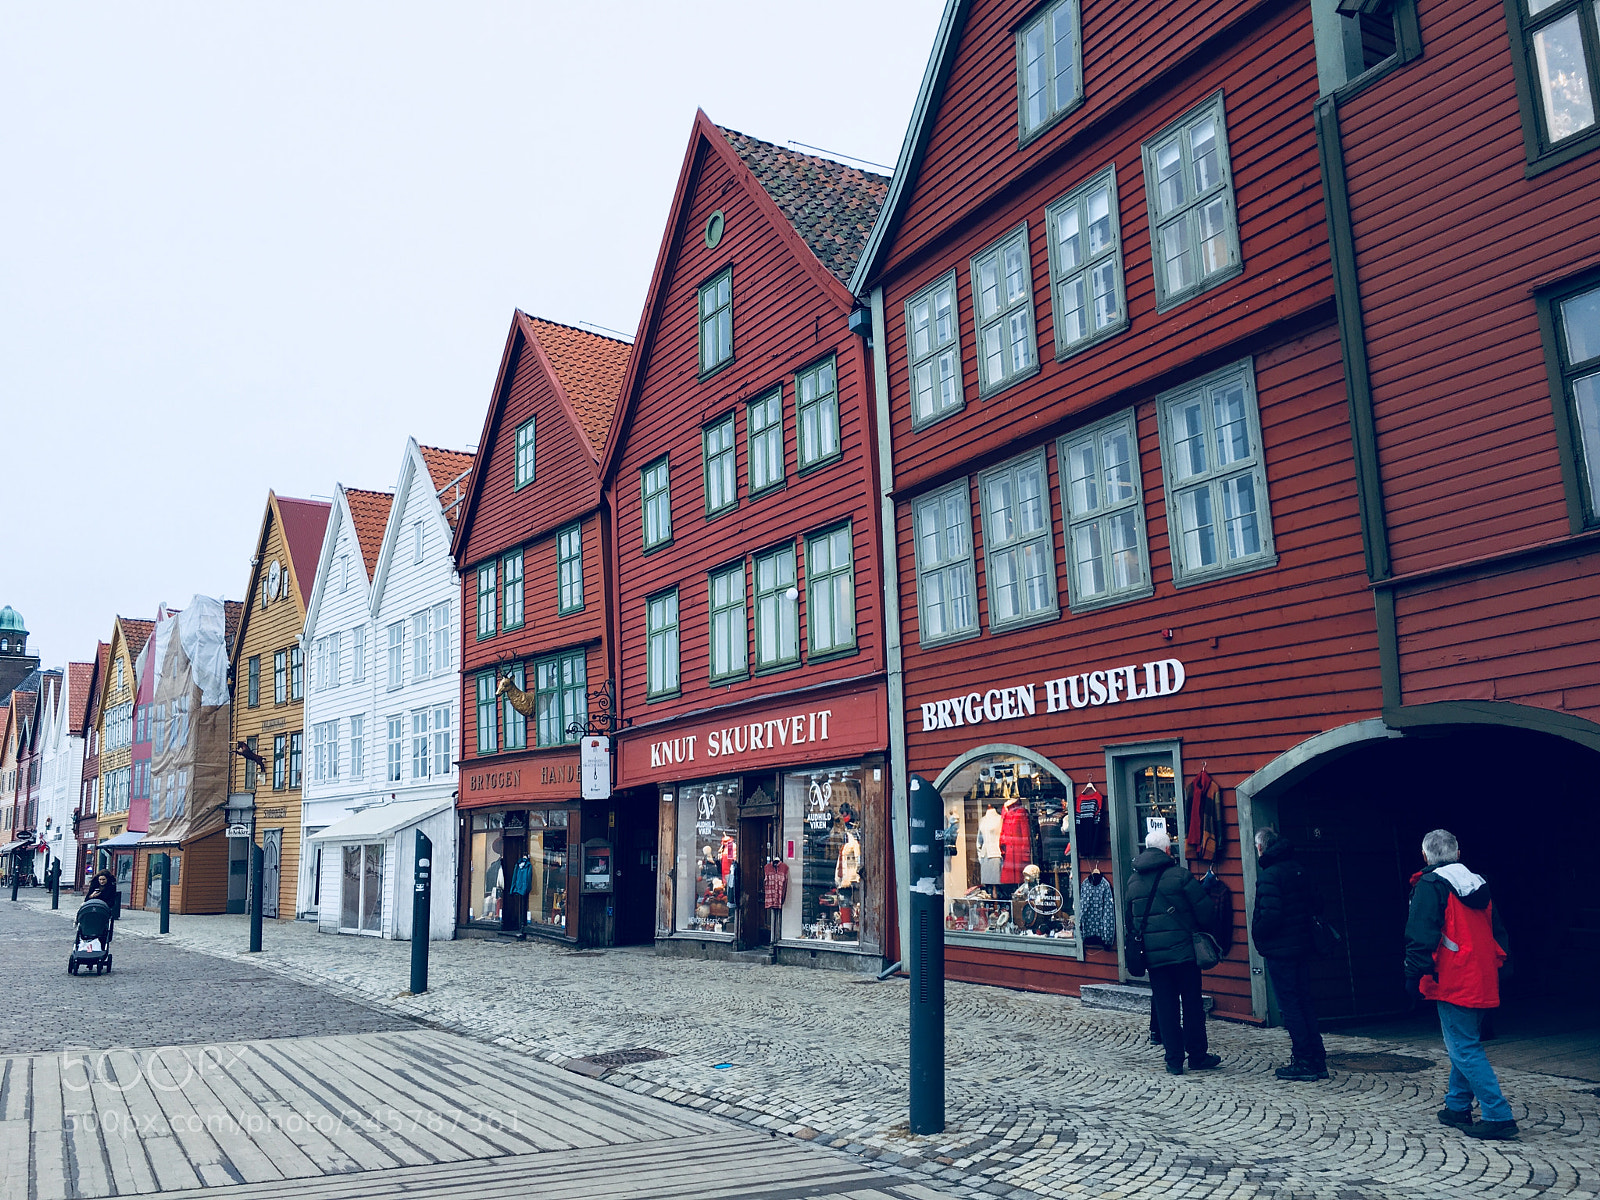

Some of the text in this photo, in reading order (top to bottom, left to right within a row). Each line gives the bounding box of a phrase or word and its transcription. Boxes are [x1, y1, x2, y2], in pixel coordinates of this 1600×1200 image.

[921, 658, 1186, 732] BRYGGEN HUSFLID
[650, 710, 832, 768] KNUT SKURTVEIT
[470, 764, 581, 791] BRYGGEN HANDE
[809, 820, 827, 830] VIKEN
